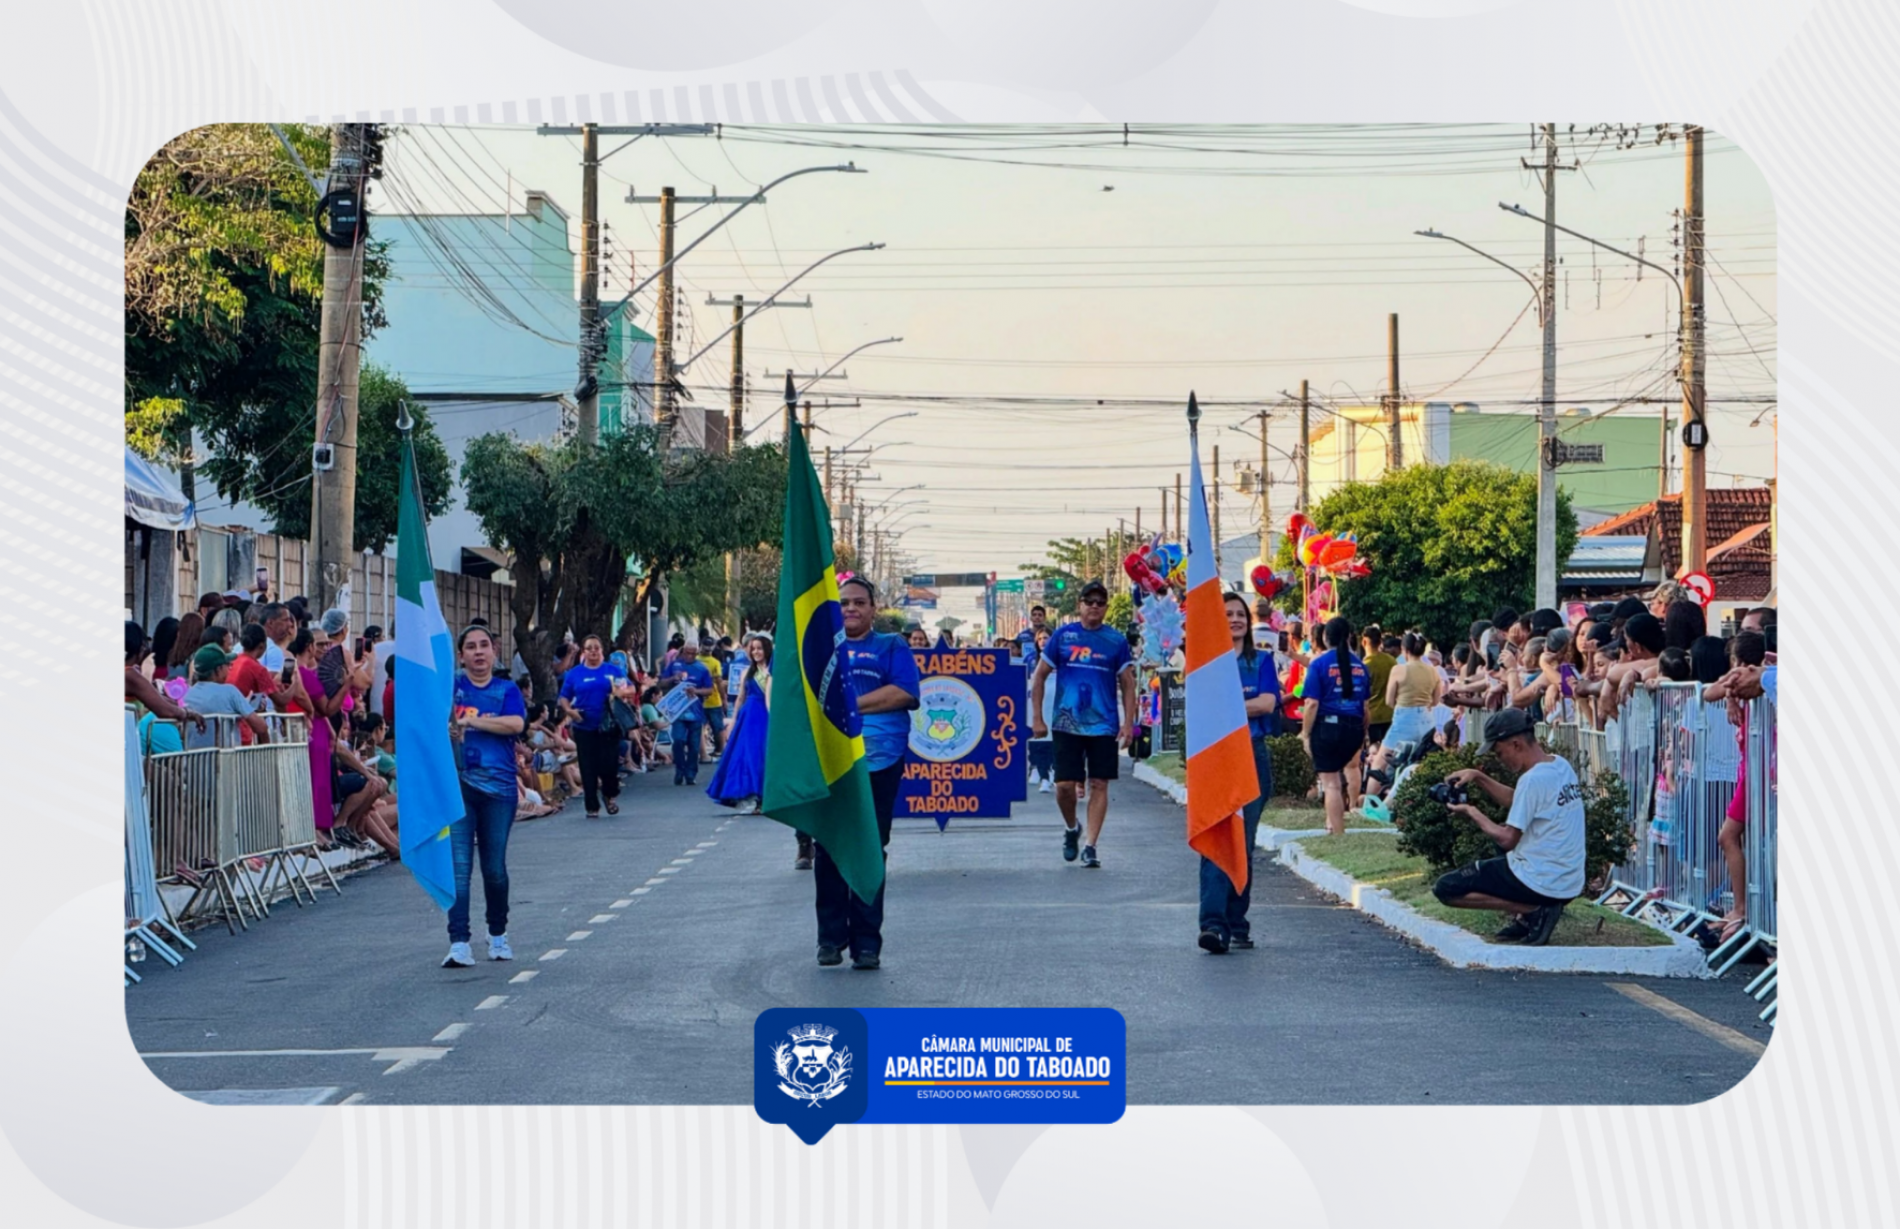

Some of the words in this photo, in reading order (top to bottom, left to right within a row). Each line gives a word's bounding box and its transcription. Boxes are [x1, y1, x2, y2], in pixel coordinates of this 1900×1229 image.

[914, 649, 996, 675] RABÉNS
[1068, 645, 1092, 663] 78
[901, 763, 987, 779] APARECIDA
[931, 780, 952, 796] DO
[906, 796, 979, 813] TABOADO
